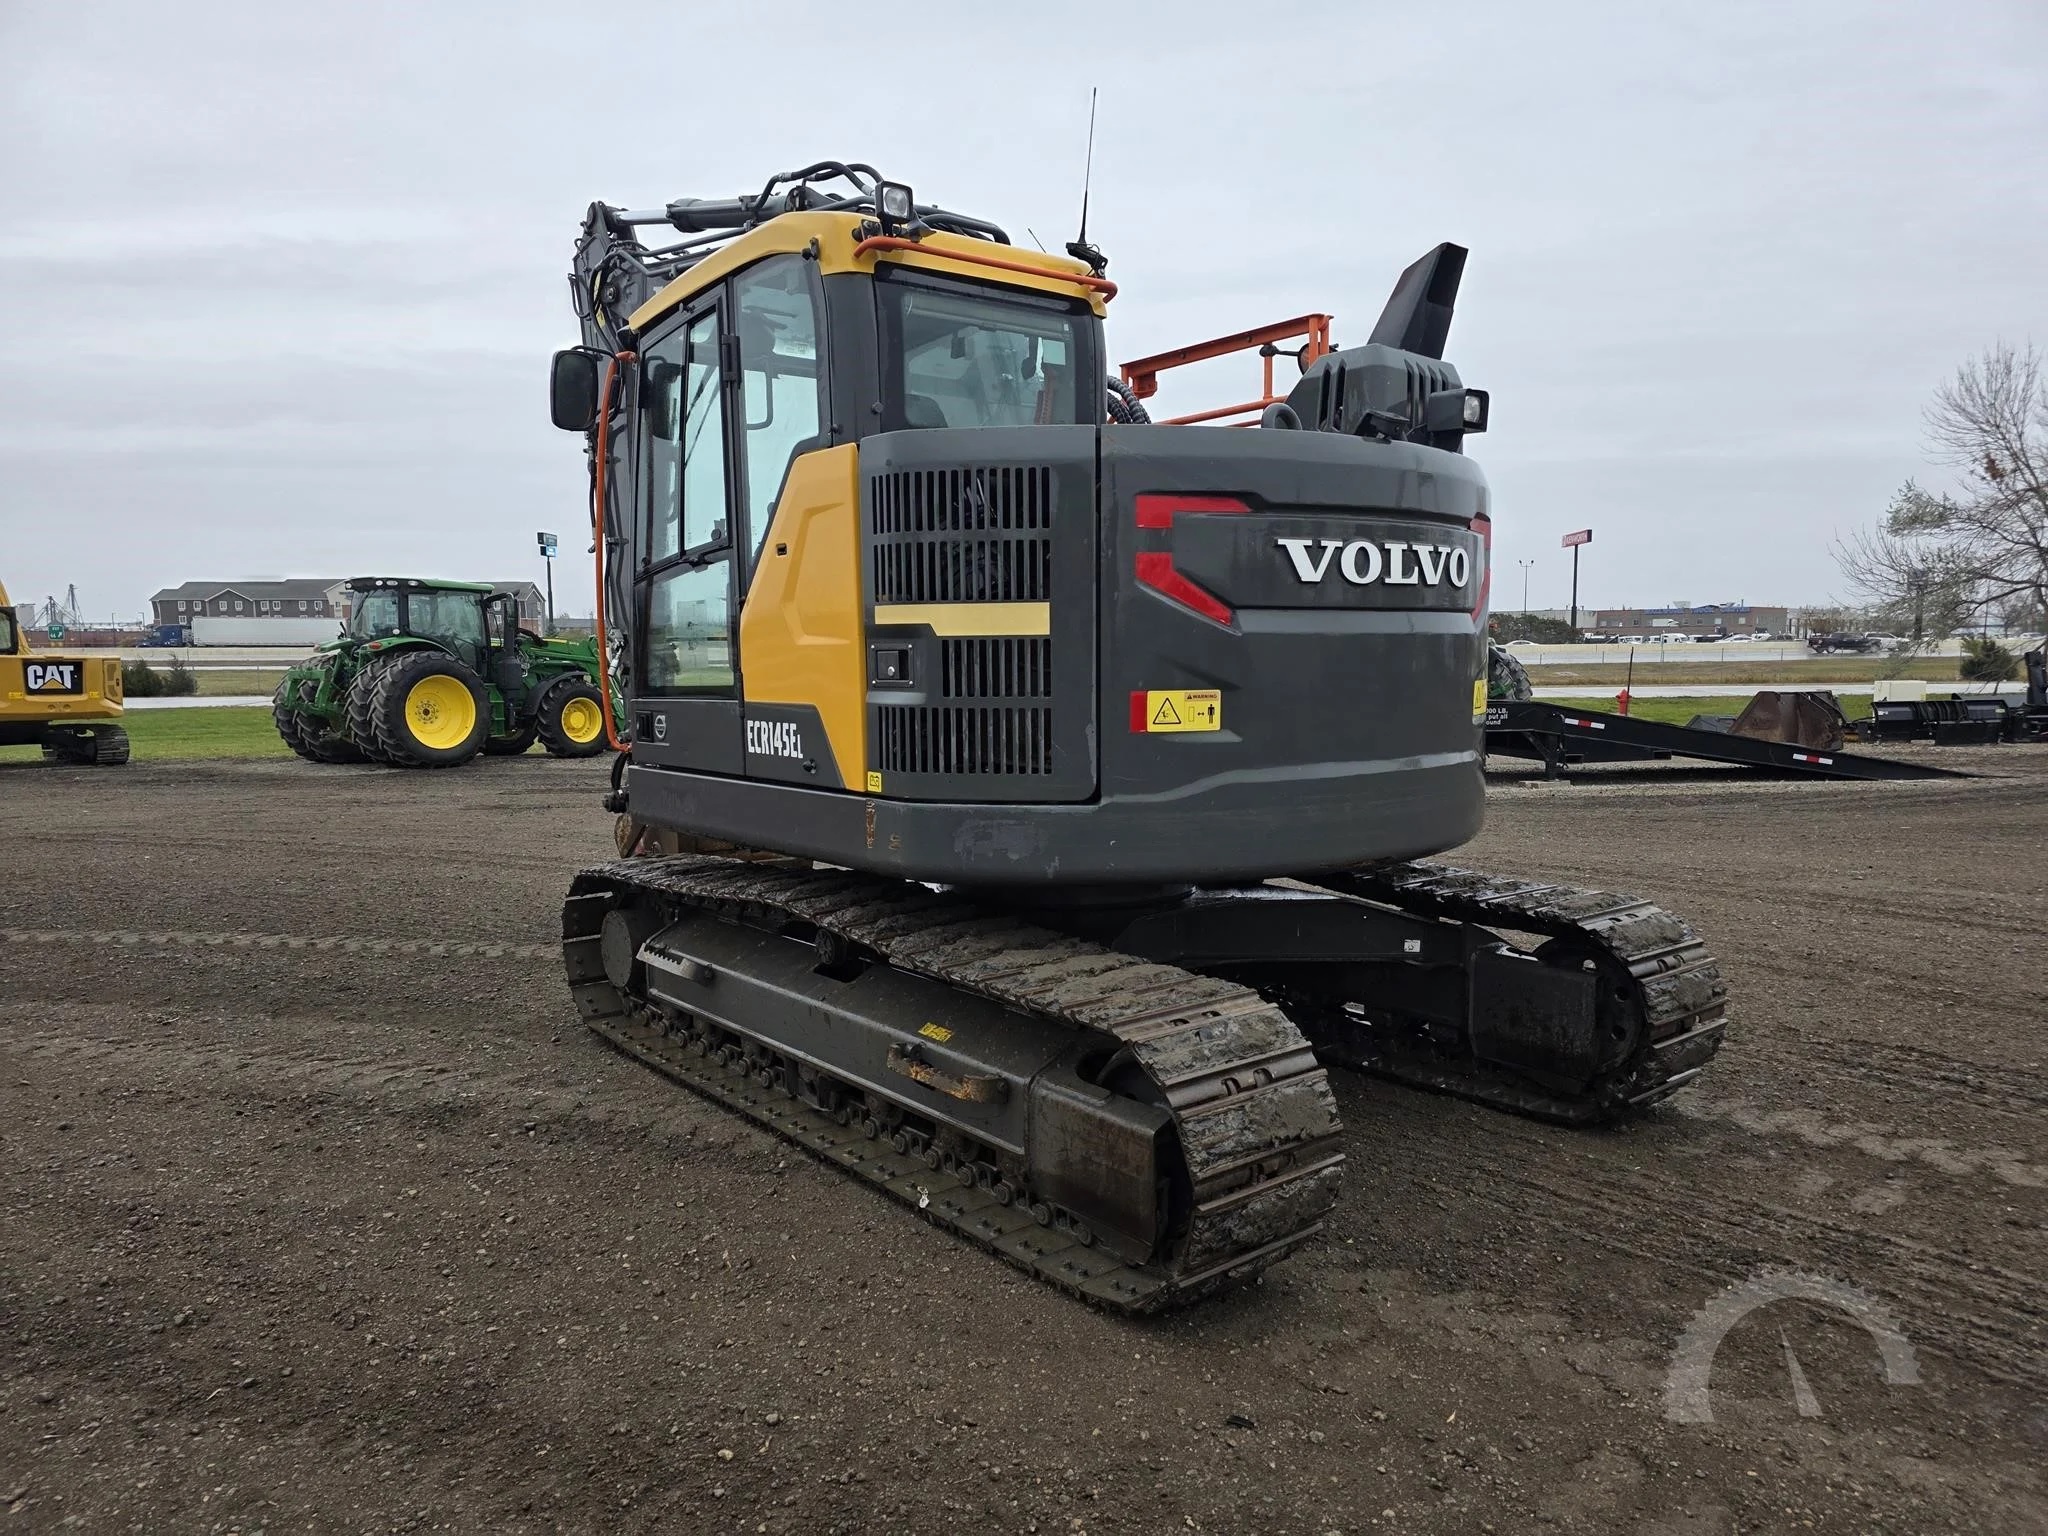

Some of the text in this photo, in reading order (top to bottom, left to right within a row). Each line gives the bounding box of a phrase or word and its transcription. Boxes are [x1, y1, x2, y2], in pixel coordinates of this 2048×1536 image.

[1277, 538, 1470, 588] VOLVO
[27, 665, 74, 690] CAT
[747, 720, 804, 759] ECR145EL
